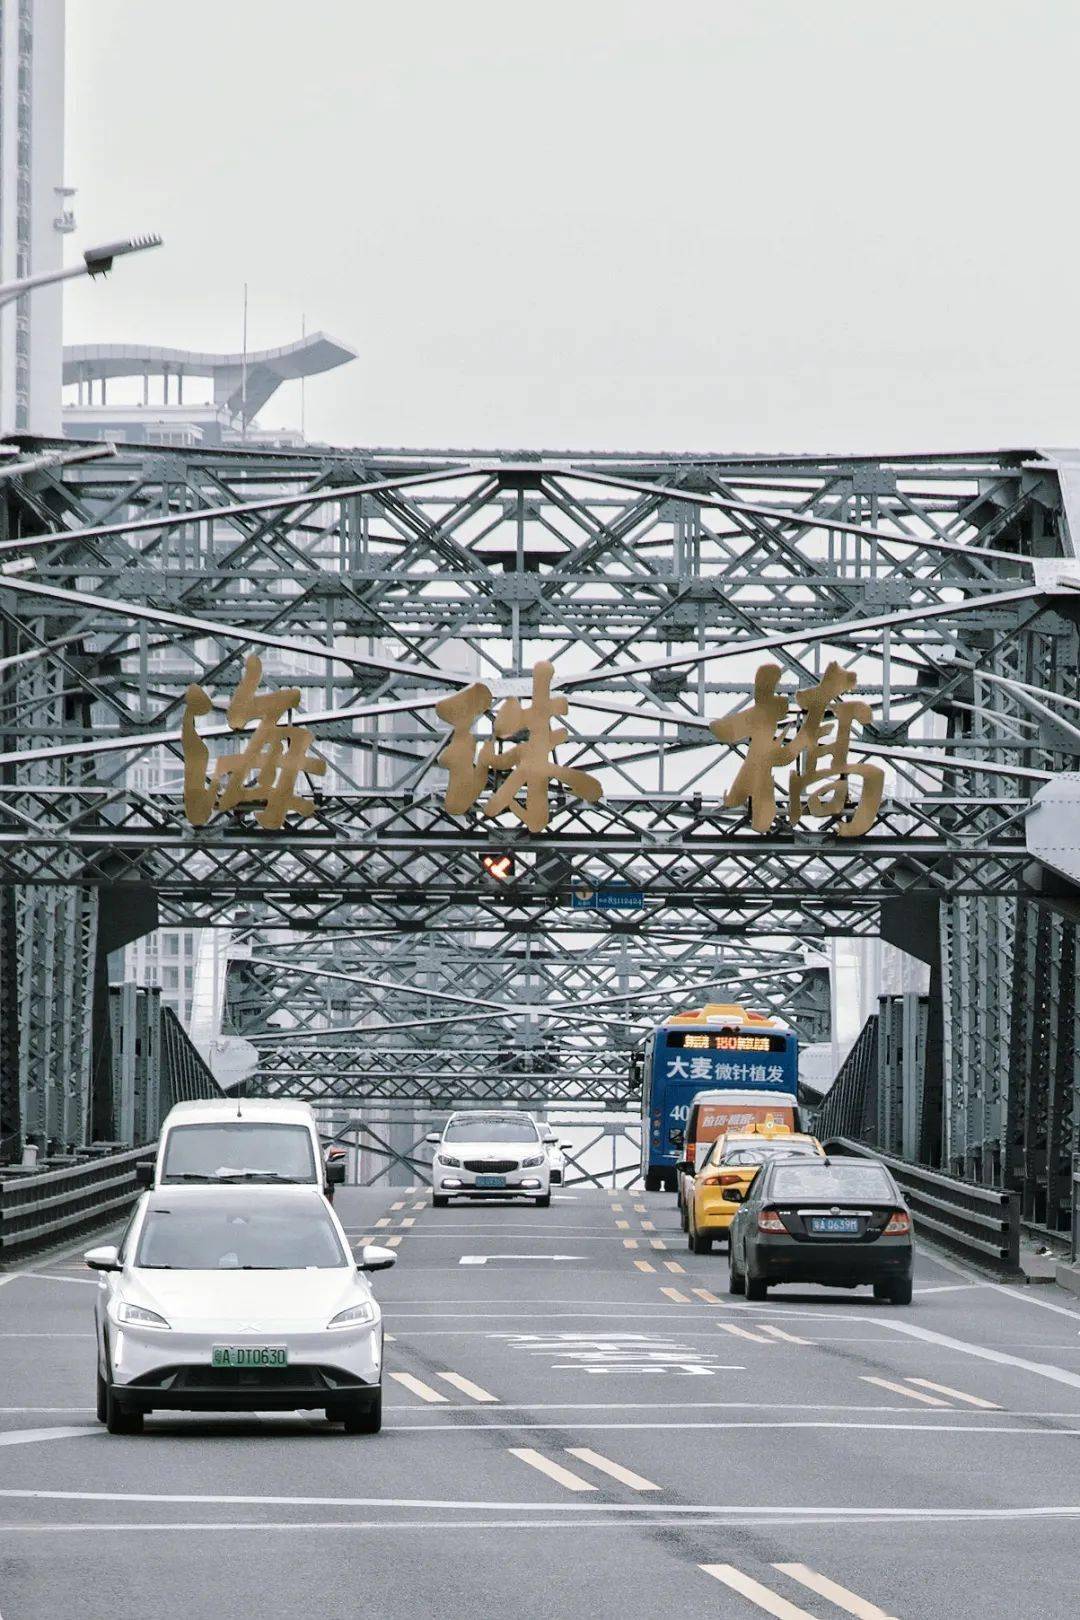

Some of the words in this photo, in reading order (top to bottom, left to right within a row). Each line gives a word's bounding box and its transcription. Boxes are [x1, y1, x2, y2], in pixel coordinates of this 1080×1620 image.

[715, 1036, 738, 1050] 180
[666, 1055, 713, 1080] 大麦
[715, 1062, 784, 1083] 微针植发
